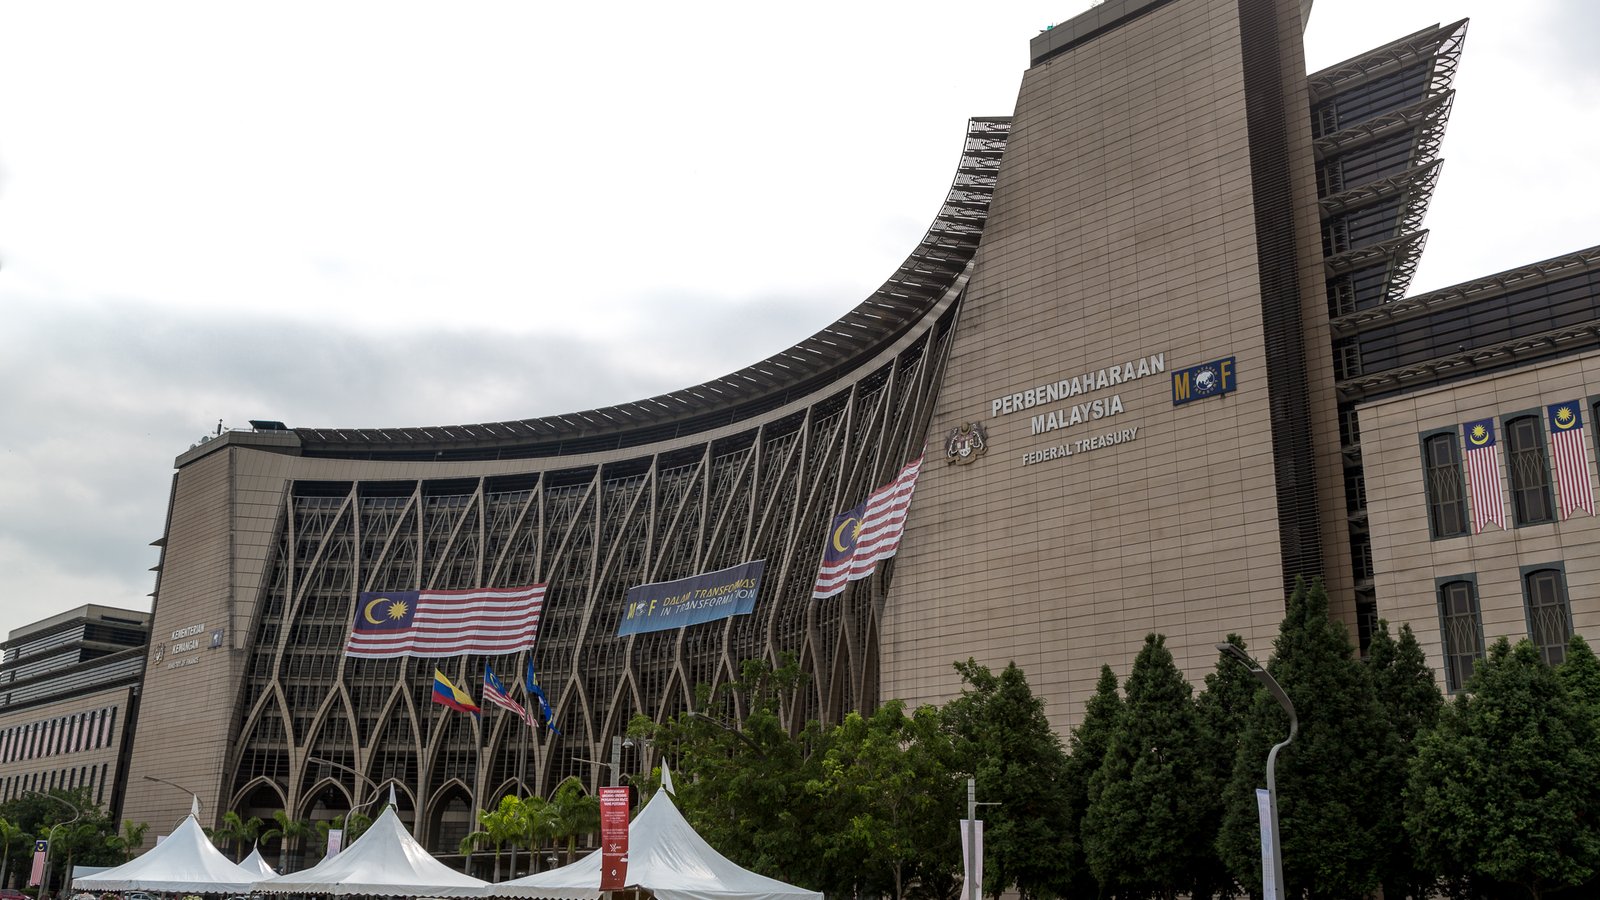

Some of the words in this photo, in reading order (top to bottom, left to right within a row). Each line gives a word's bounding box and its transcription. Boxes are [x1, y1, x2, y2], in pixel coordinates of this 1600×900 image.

[991, 352, 1166, 417] PERBENDAHARAAN
[1031, 394, 1125, 436] MALAYSIA
[1022, 444, 1073, 466] FEDERAL
[1075, 426, 1139, 455] TREASURY
[660, 607, 671, 616] IN
[676, 589, 756, 613] TRANSFORMATION
[663, 592, 691, 606] DALAM
[171, 623, 205, 641] KEMENTERIAN
[172, 639, 199, 655] KEWANGAN
